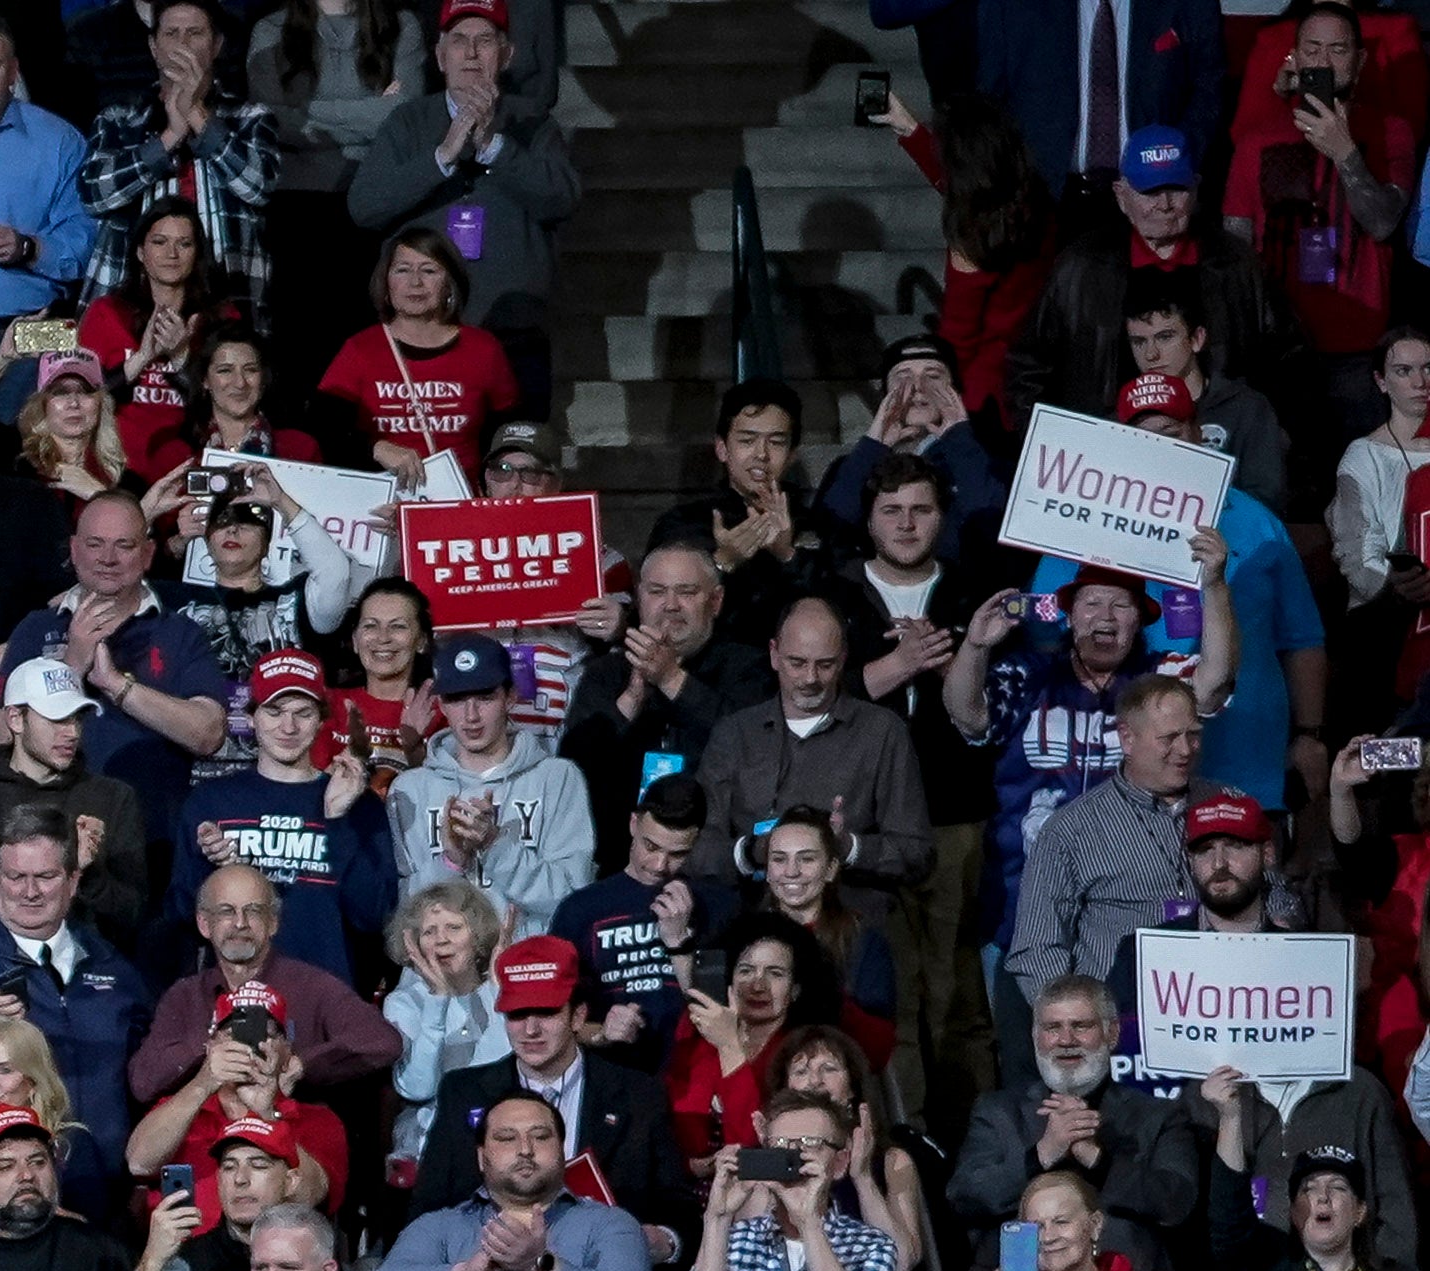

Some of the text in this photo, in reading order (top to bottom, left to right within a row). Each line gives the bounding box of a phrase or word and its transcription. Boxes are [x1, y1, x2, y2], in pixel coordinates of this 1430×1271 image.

[1139, 147, 1180, 164] TRUMP
[375, 381, 464, 401] WOMEN
[372, 415, 469, 435] TRUMP
[1032, 441, 1207, 526] Women
[1042, 498, 1181, 547] FOR TRUMP
[417, 530, 585, 564] TRUMP
[433, 556, 571, 585] PENCE
[474, 580, 520, 593] AMERICA
[495, 618, 518, 629] 2020
[259, 815, 305, 831] 2020
[257, 862, 303, 878] AMERICA
[625, 971, 661, 989] 2020
[1150, 967, 1334, 1020] Women
[1171, 1024, 1316, 1044] FOR TRUMP
